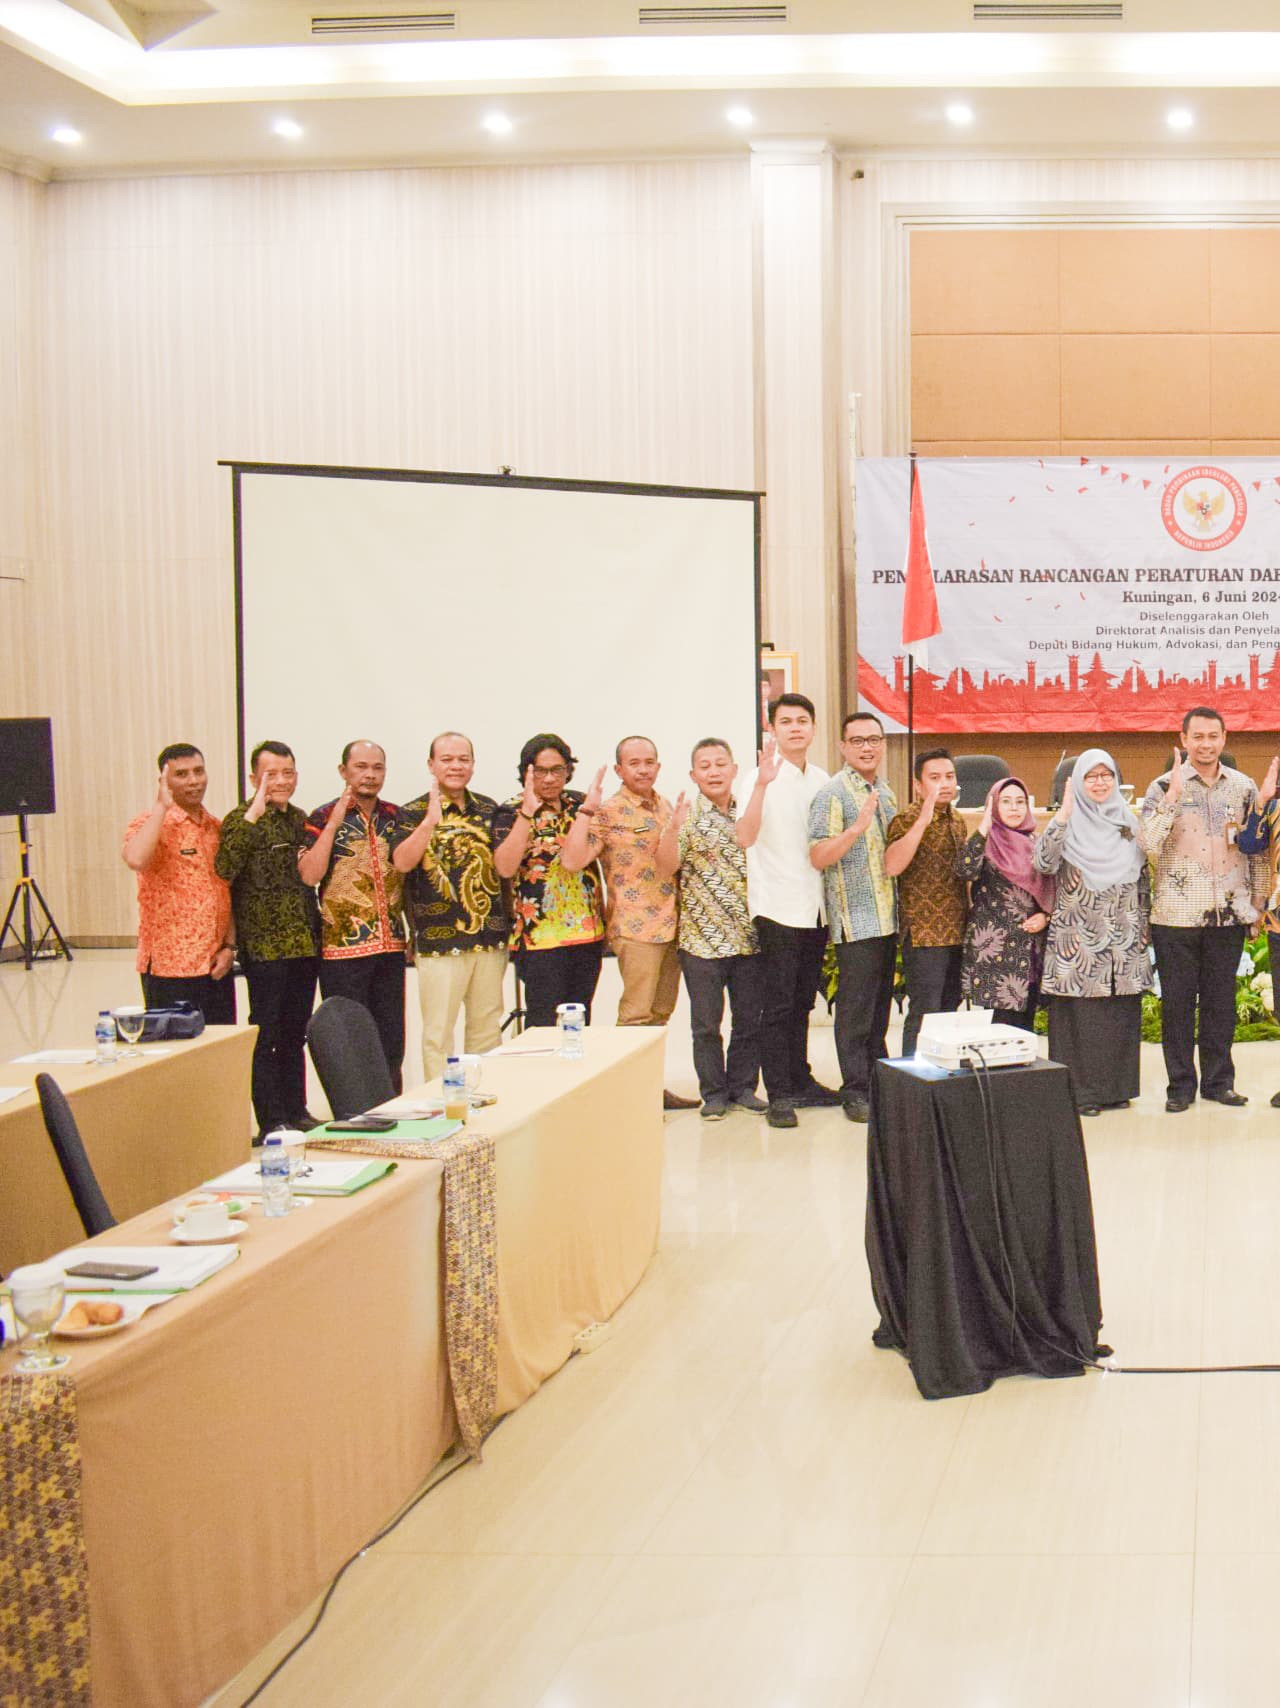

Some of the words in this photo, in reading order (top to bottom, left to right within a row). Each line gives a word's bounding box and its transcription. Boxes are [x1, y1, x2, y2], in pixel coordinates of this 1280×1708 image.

[872, 569, 1014, 584] PENLARASAN
[1019, 568, 1129, 583] RANCANGAN
[1135, 568, 1244, 583] PERATURAN
[1122, 590, 1197, 606] Kuningan,
[1202, 591, 1210, 603] 6
[1215, 590, 1247, 603] Juni
[1139, 611, 1239, 623] Diselenggarakan
[1242, 611, 1270, 621] Oleh
[1095, 625, 1156, 636] Direktorat
[1160, 625, 1205, 636] Analisis
[1209, 625, 1231, 636] dan
[1028, 640, 1068, 652] Deputi
[1071, 640, 1113, 652] Bidang
[1116, 639, 1161, 651] Hukum,
[1165, 639, 1222, 651] Advokasi,
[1226, 639, 1248, 650] dan
